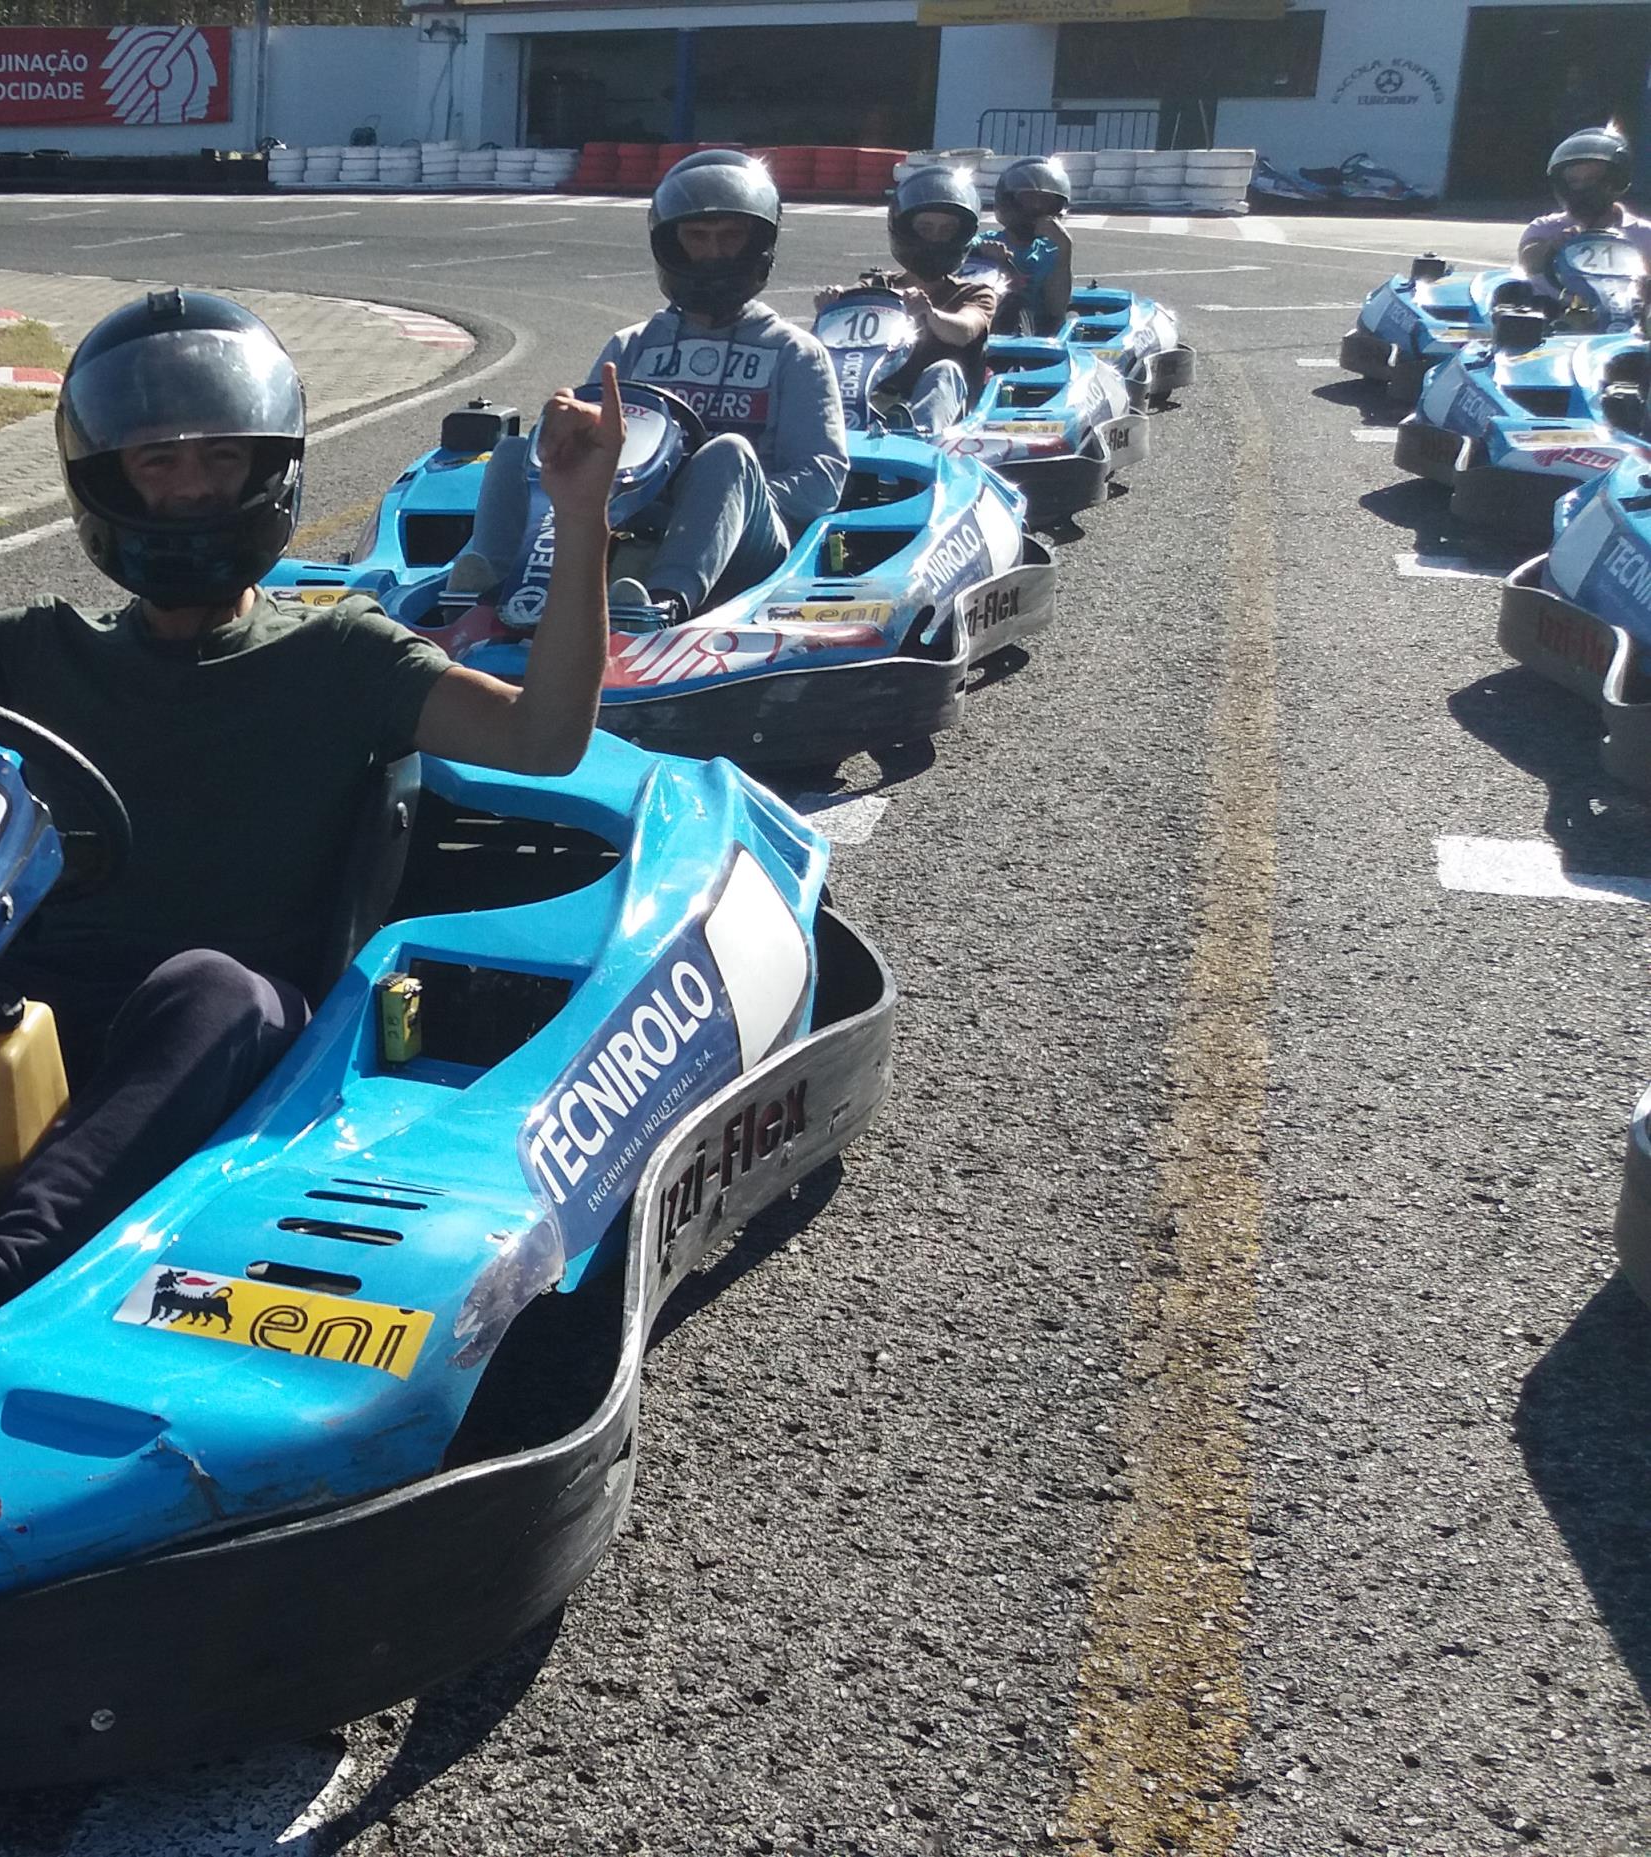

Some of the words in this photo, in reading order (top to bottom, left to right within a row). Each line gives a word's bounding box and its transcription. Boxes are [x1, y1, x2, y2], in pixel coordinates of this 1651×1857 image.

[1581, 245, 1613, 268] 21
[844, 312, 880, 342] 10
[725, 350, 762, 380] 78
[815, 602, 882, 622] eni
[528, 960, 714, 1206] TECNIROLO
[587, 1136, 644, 1213] ENGENHARIA
[249, 1305, 416, 1371] eni
